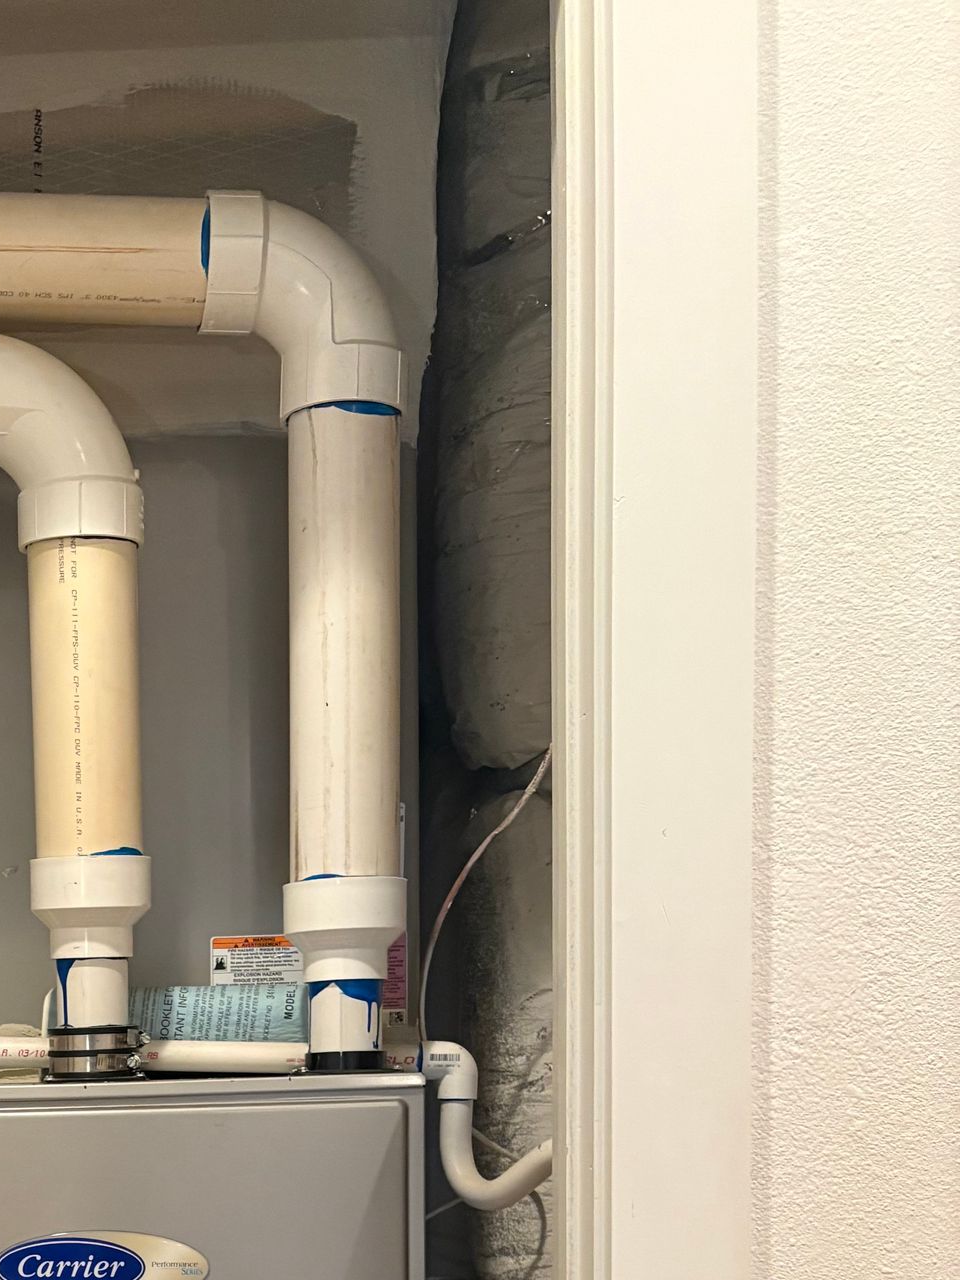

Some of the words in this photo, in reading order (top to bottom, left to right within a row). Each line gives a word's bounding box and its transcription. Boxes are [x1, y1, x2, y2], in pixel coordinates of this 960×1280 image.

[70, 560, 78, 578] FOR
[74, 761, 82, 785] MADE
[75, 791, 83, 802] IN
[283, 989, 296, 1020] MODEL
[17, 1254, 125, 1279] Carrier
